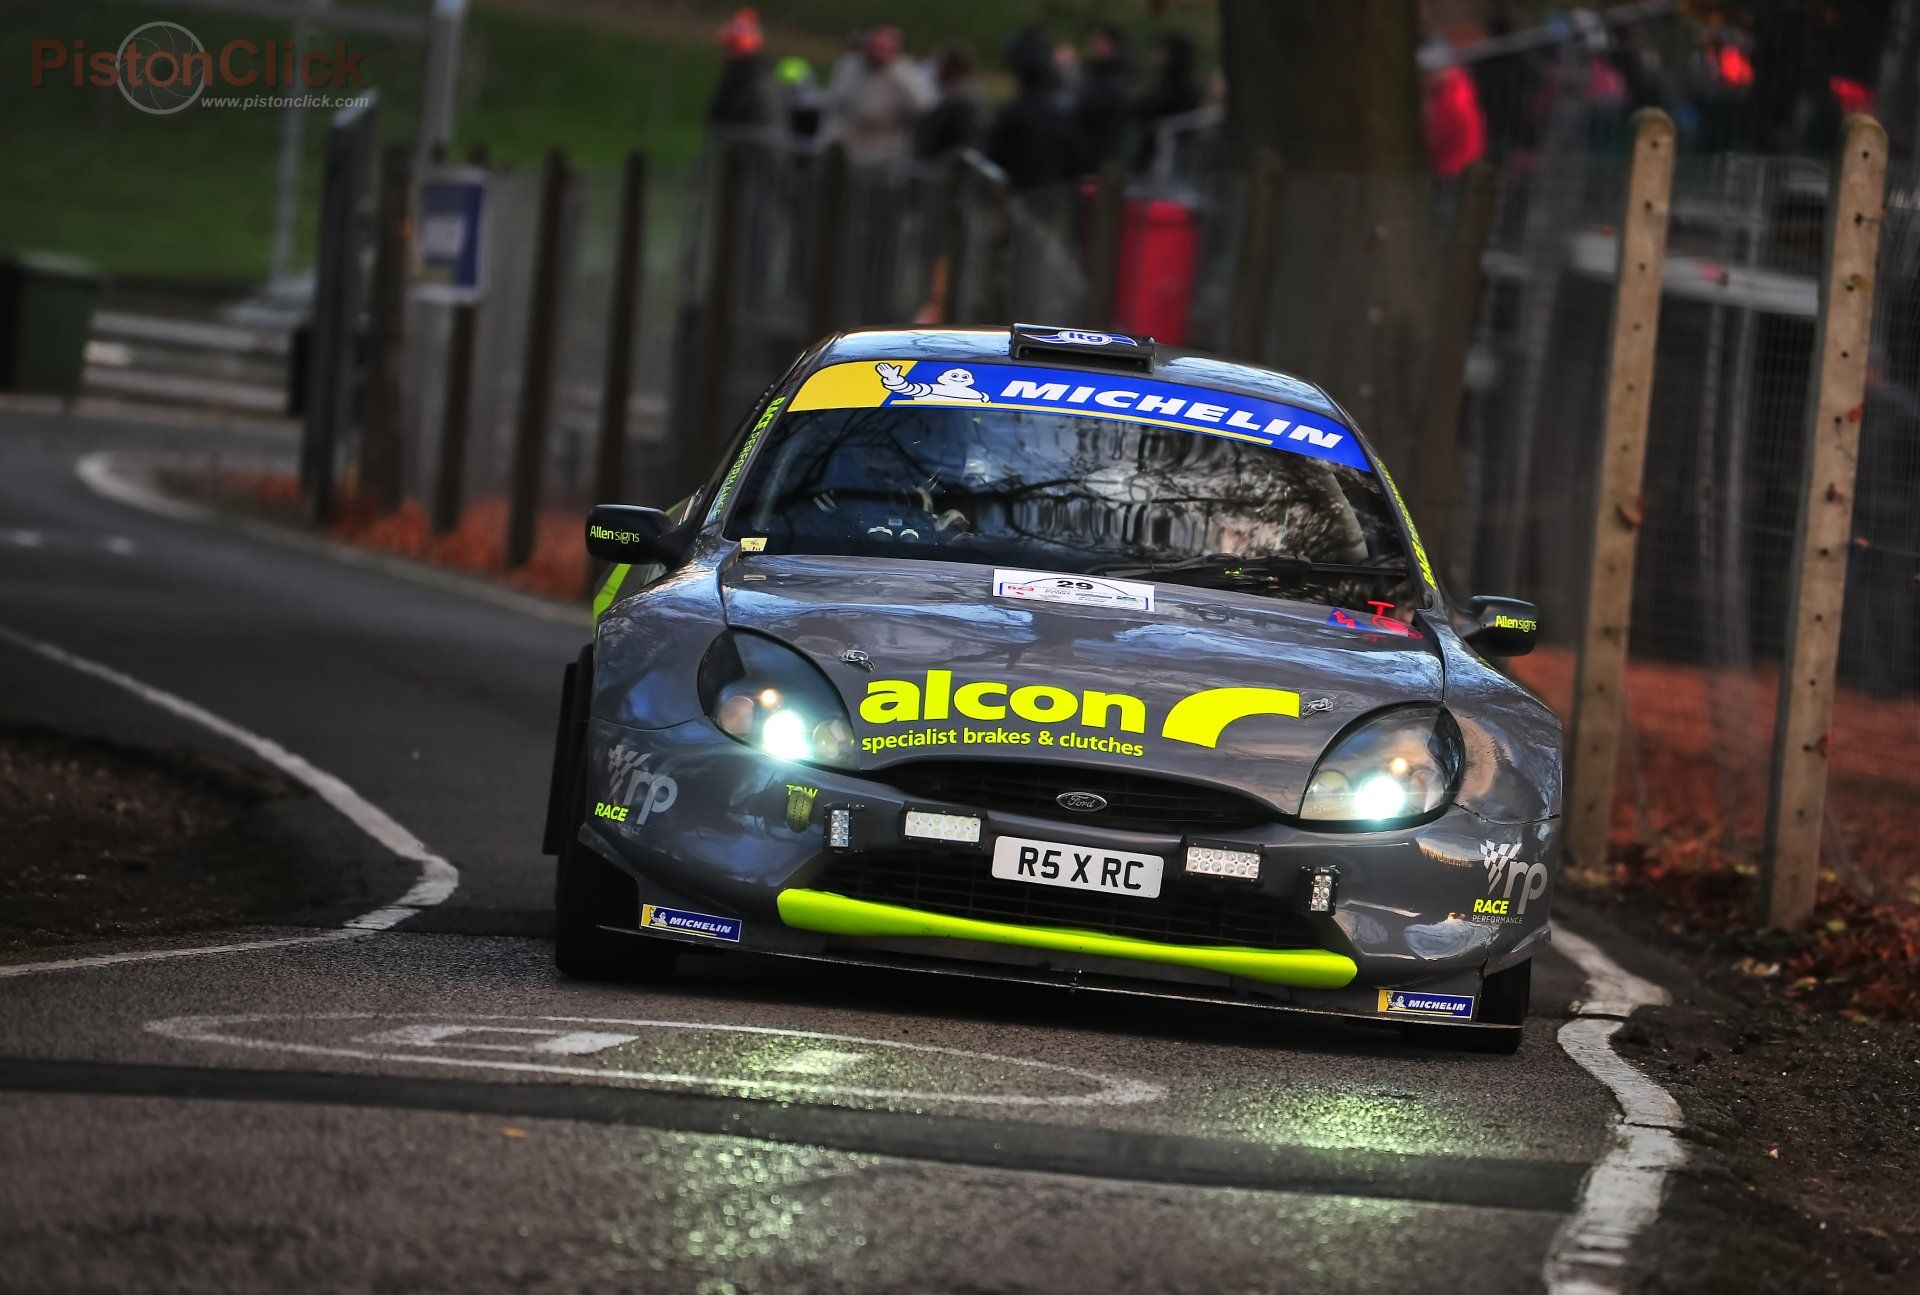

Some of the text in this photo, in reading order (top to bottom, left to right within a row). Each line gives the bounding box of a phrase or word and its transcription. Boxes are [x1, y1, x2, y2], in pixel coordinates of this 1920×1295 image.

[1000, 380, 1343, 449] MICHELIN
[1056, 580, 1094, 590] 29
[859, 669, 1146, 734] alcon
[862, 727, 1144, 757] specialist brakes & clutches
[1067, 795, 1095, 808] Ford
[594, 802, 629, 822] RACE
[1017, 846, 1144, 890] R5 X RC
[1473, 898, 1510, 915] RACE
[669, 917, 732, 934] MICHELIN
[1472, 914, 1523, 924] PERFORMANCE
[1408, 1000, 1466, 1011] MICHELIN
